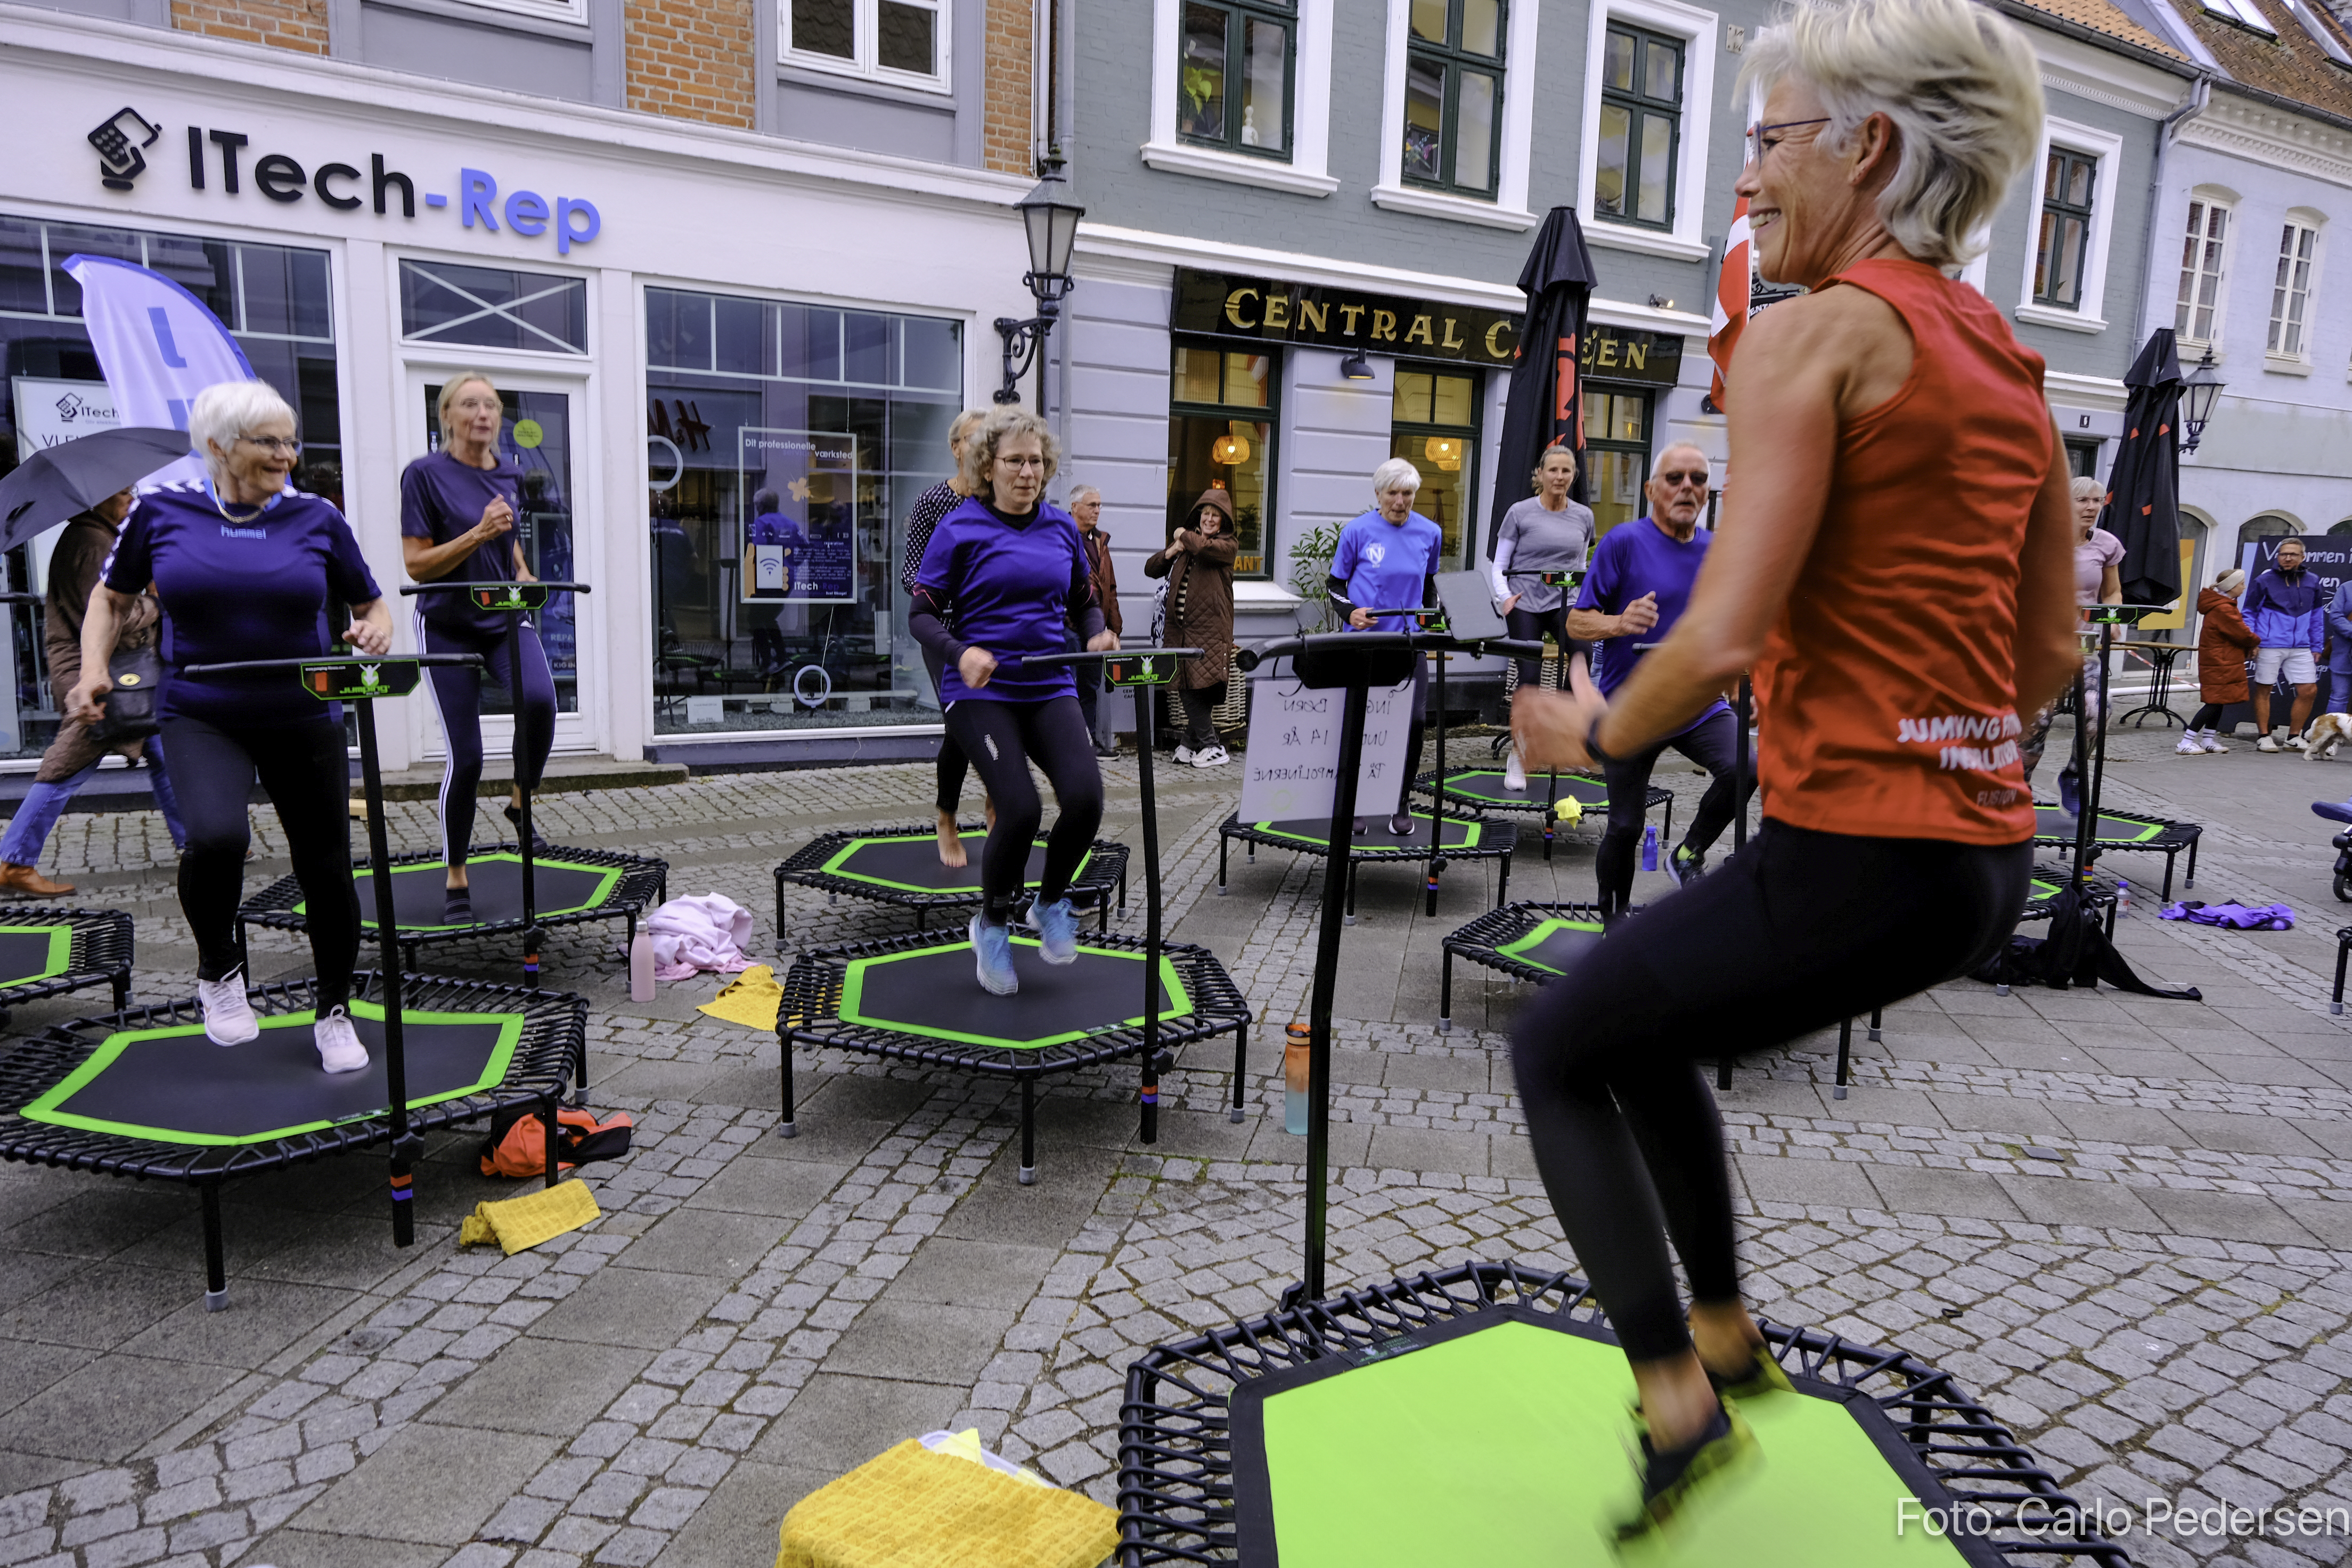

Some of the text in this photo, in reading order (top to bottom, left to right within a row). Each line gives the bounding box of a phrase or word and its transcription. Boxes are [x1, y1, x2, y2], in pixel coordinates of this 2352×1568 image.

[187, 125, 601, 254] ITech-Rep
[1224, 287, 1464, 350] CENTRAL
[745, 438, 816, 451] Dit professionelle
[815, 450, 852, 460] værksted
[221, 525, 266, 540] hummel
